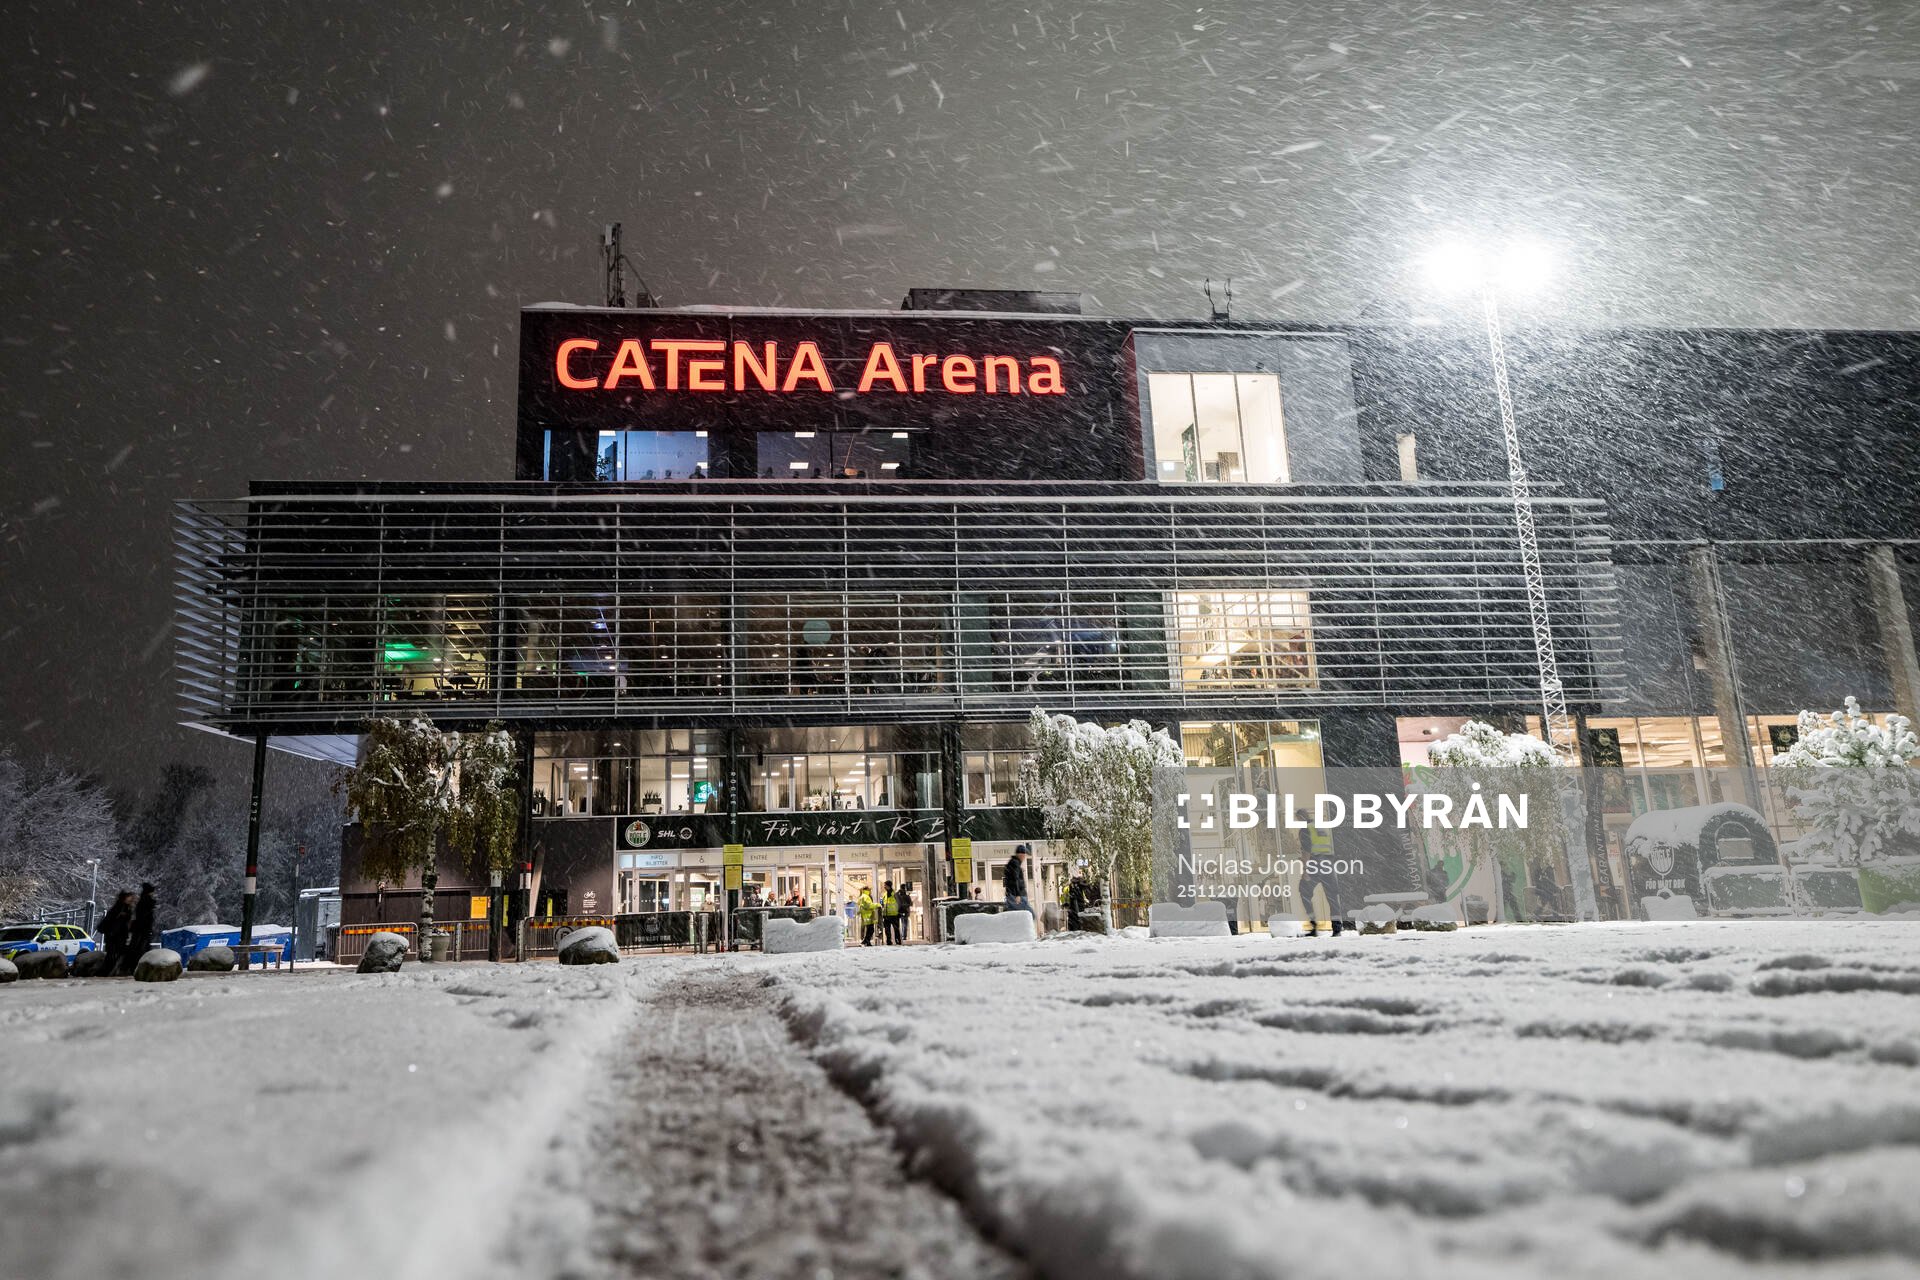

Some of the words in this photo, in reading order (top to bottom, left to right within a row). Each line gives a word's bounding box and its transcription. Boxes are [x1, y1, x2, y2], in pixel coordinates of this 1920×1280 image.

[556, 338, 834, 393] CATENA
[857, 341, 1067, 395] Arena
[657, 830, 676, 838] SHL
[761, 819, 803, 842] För
[816, 818, 873, 836] vårt
